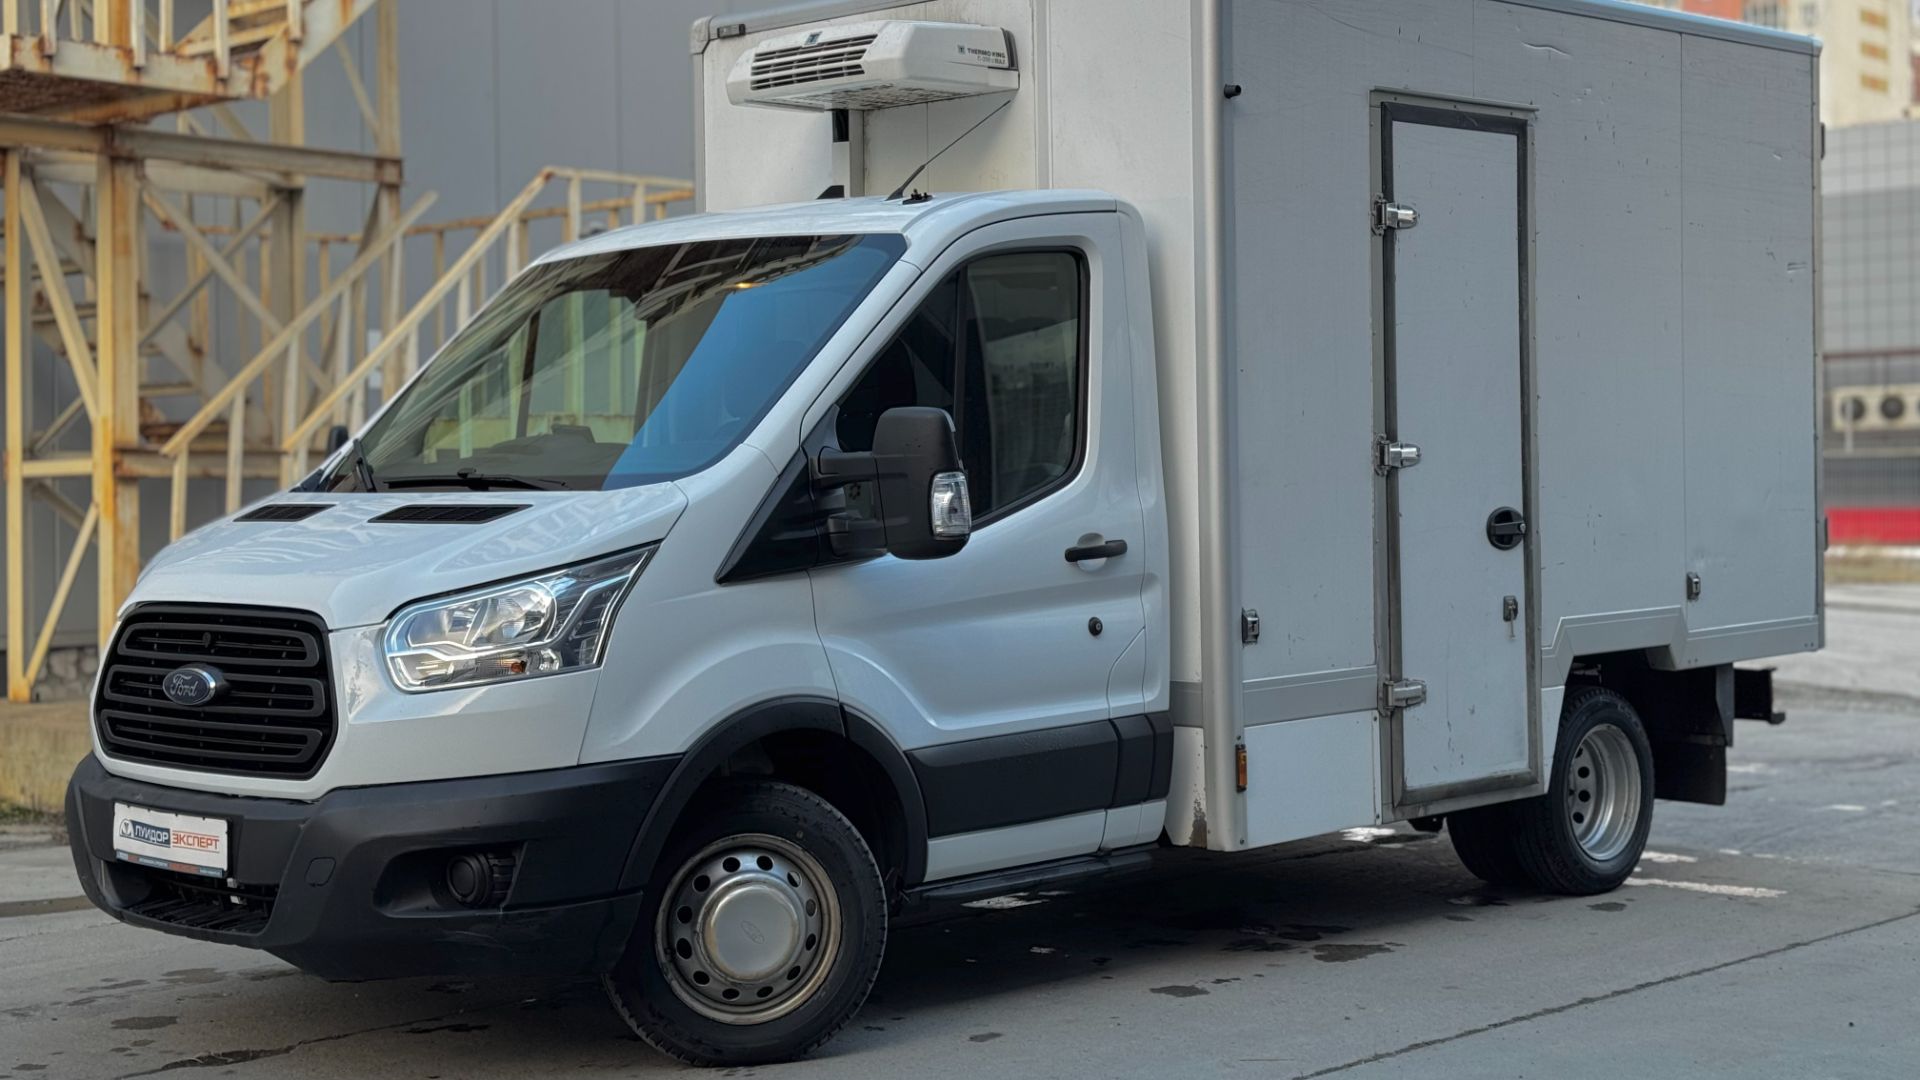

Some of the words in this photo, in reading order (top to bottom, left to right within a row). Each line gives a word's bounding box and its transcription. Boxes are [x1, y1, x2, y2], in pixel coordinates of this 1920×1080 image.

[967, 48, 991, 57] THERMO
[169, 673, 199, 697] Ford
[135, 825, 169, 843] ЛУИДОР
[172, 832, 220, 850] ЭКСПЕРТ
